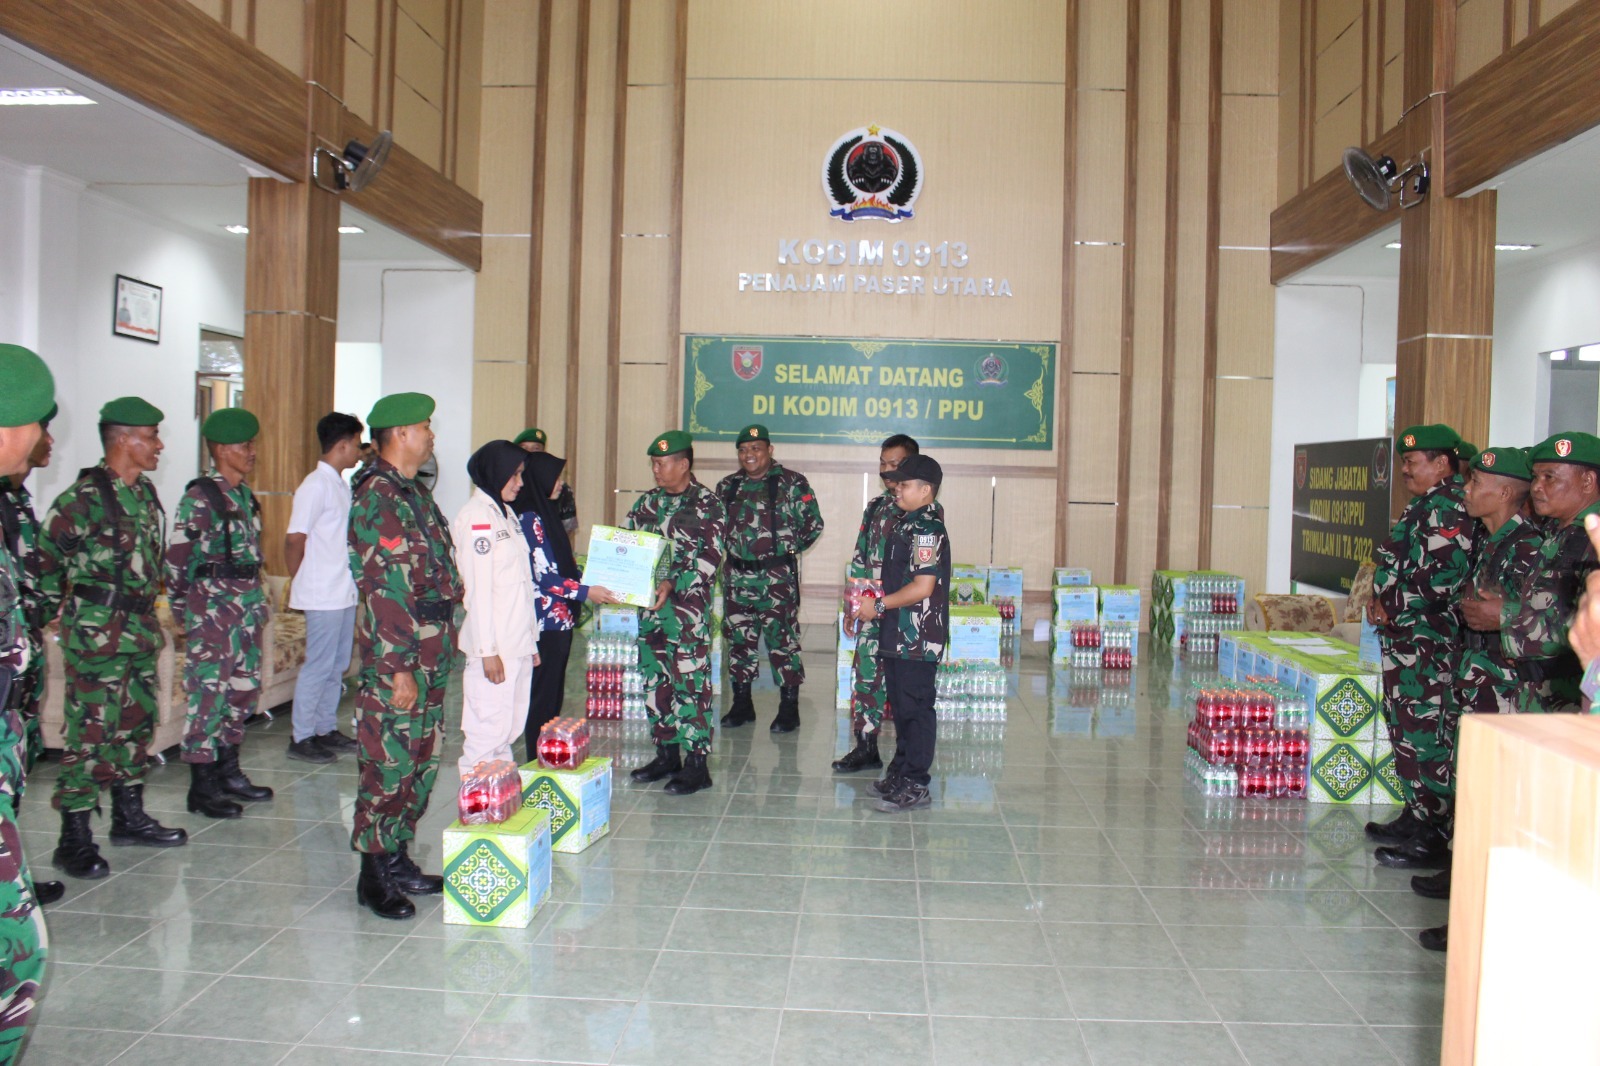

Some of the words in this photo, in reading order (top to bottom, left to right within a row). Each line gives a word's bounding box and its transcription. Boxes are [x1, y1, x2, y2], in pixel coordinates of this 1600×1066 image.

[778, 239, 884, 266] KODIM
[892, 240, 969, 268] 0913
[738, 272, 846, 293] PENAJAM
[853, 274, 926, 295] PASER
[932, 276, 1013, 297] UTARA
[774, 364, 873, 385] SELAMAT
[879, 366, 964, 388] DATANG
[753, 394, 775, 415] DI
[783, 395, 858, 417] KODIM
[864, 398, 919, 419] 0913
[938, 399, 984, 421] PPU
[1309, 466, 1334, 490] SIDANG
[1334, 465, 1368, 491] JABATAN
[1309, 499, 1331, 523] KODIM
[1302, 529, 1335, 556] TRIWULAN
[1342, 534, 1352, 559] TA
[1353, 535, 1373, 562] 2022
